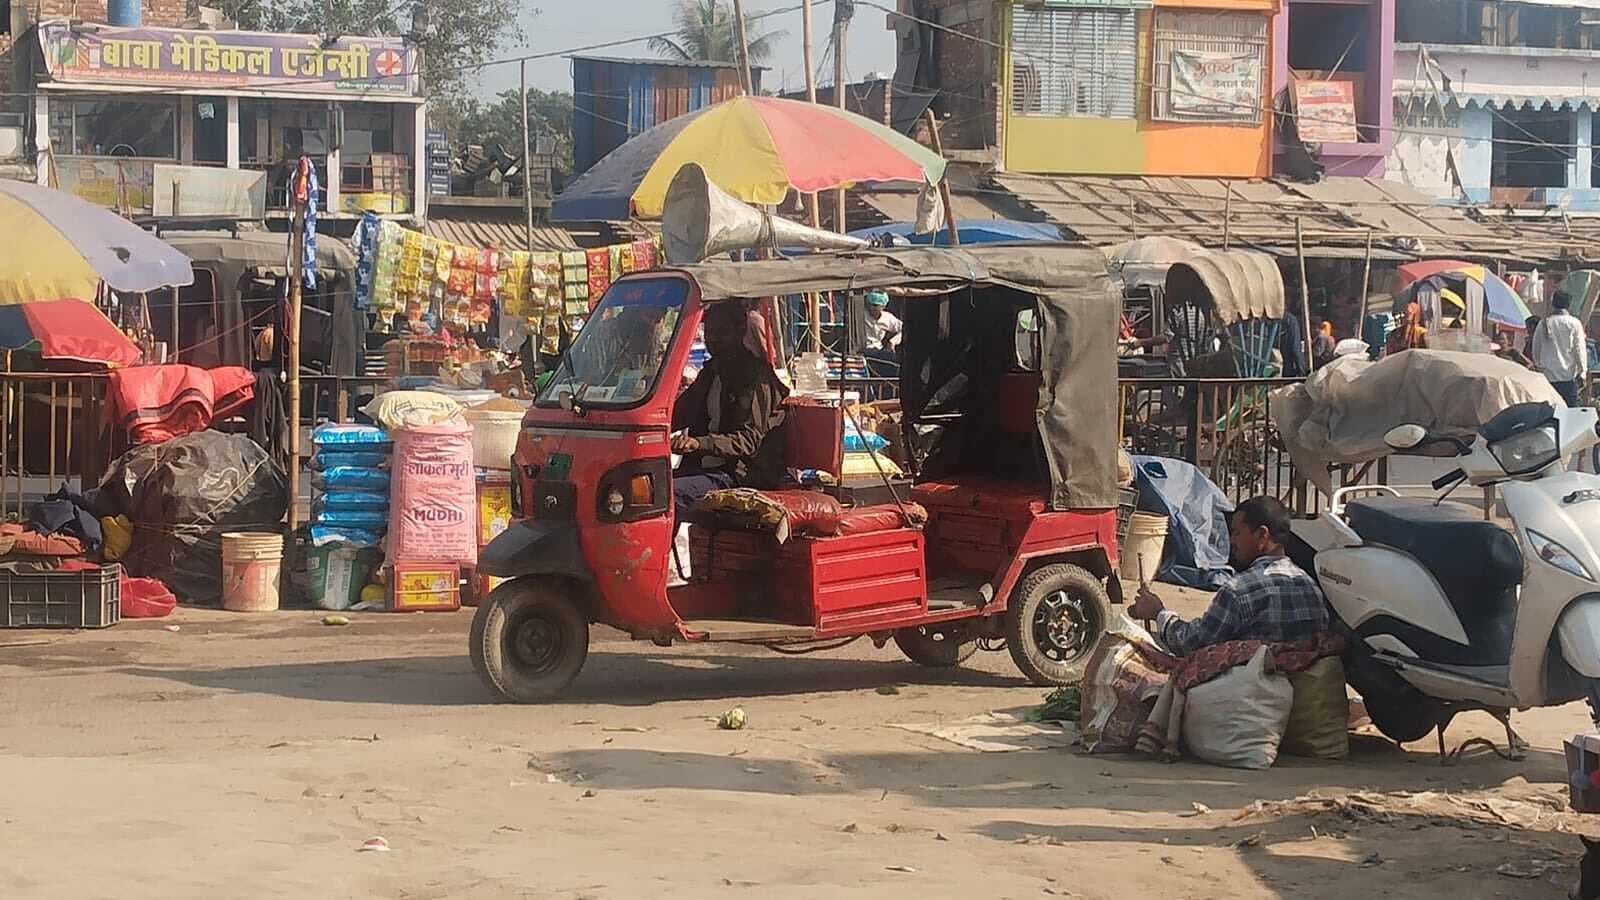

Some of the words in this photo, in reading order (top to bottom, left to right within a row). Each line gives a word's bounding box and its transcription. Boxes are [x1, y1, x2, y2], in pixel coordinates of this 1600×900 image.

[101, 38, 162, 69] बाबा
[170, 35, 273, 74] मेडिकल
[280, 40, 370, 79] एजेन्सी
